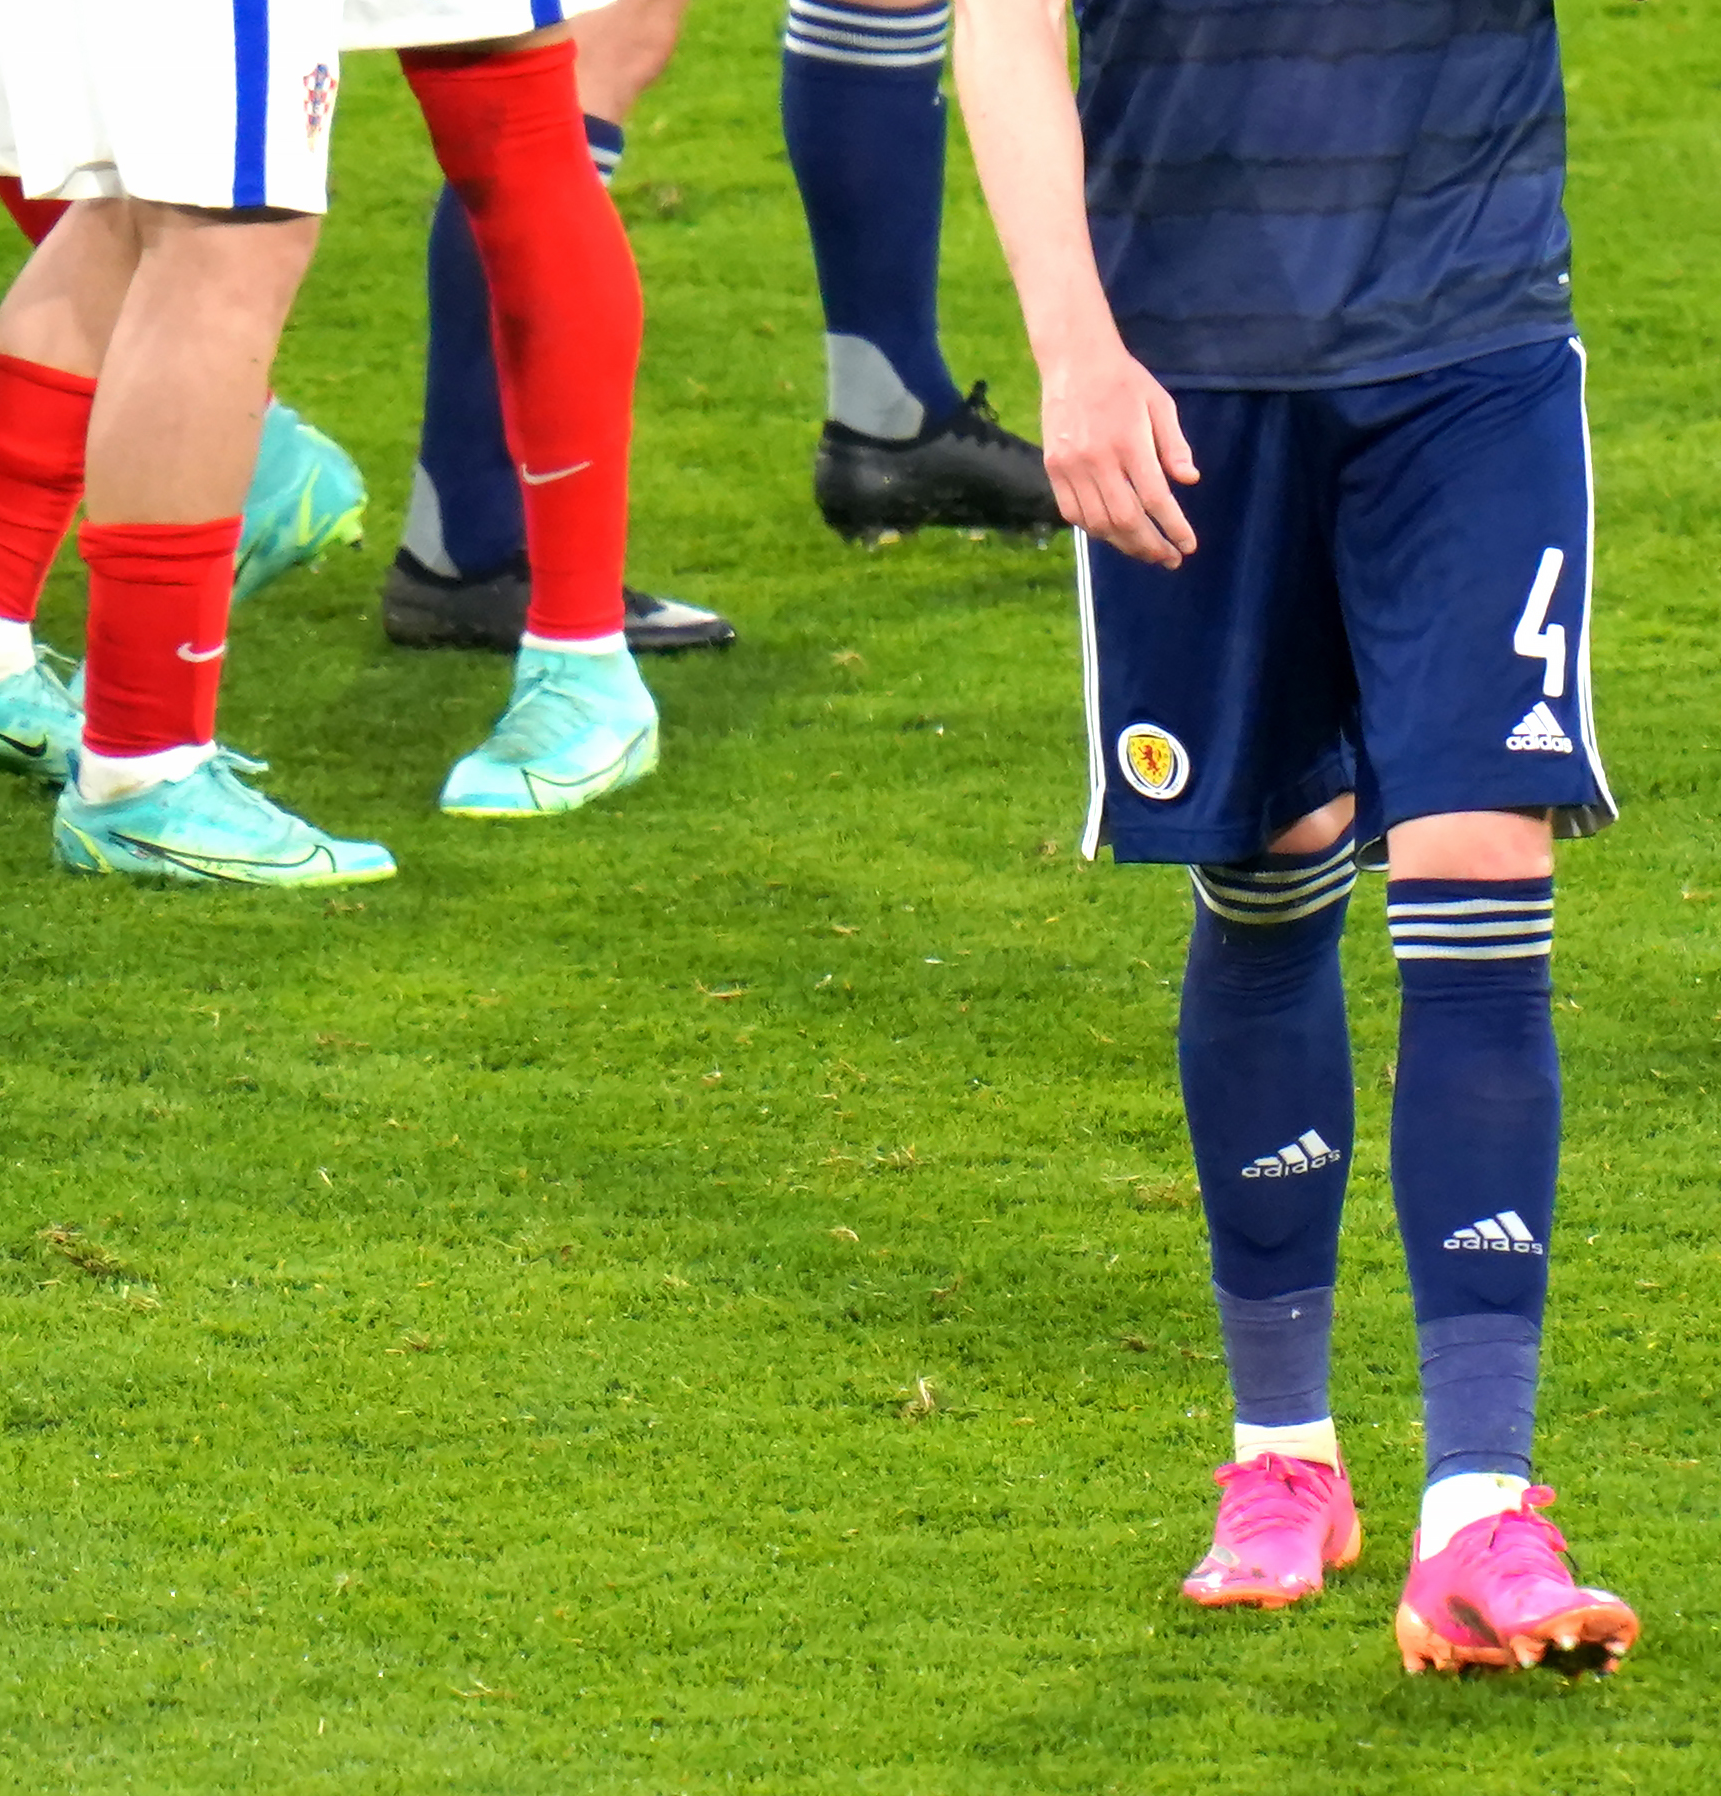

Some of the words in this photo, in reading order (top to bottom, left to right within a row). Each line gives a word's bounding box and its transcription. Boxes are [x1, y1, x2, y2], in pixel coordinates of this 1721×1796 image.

[1514, 547, 1566, 697] 4
[1506, 735, 1573, 754] adidas
[1242, 1150, 1340, 1178] adidas
[1443, 1239, 1543, 1255] adidas
